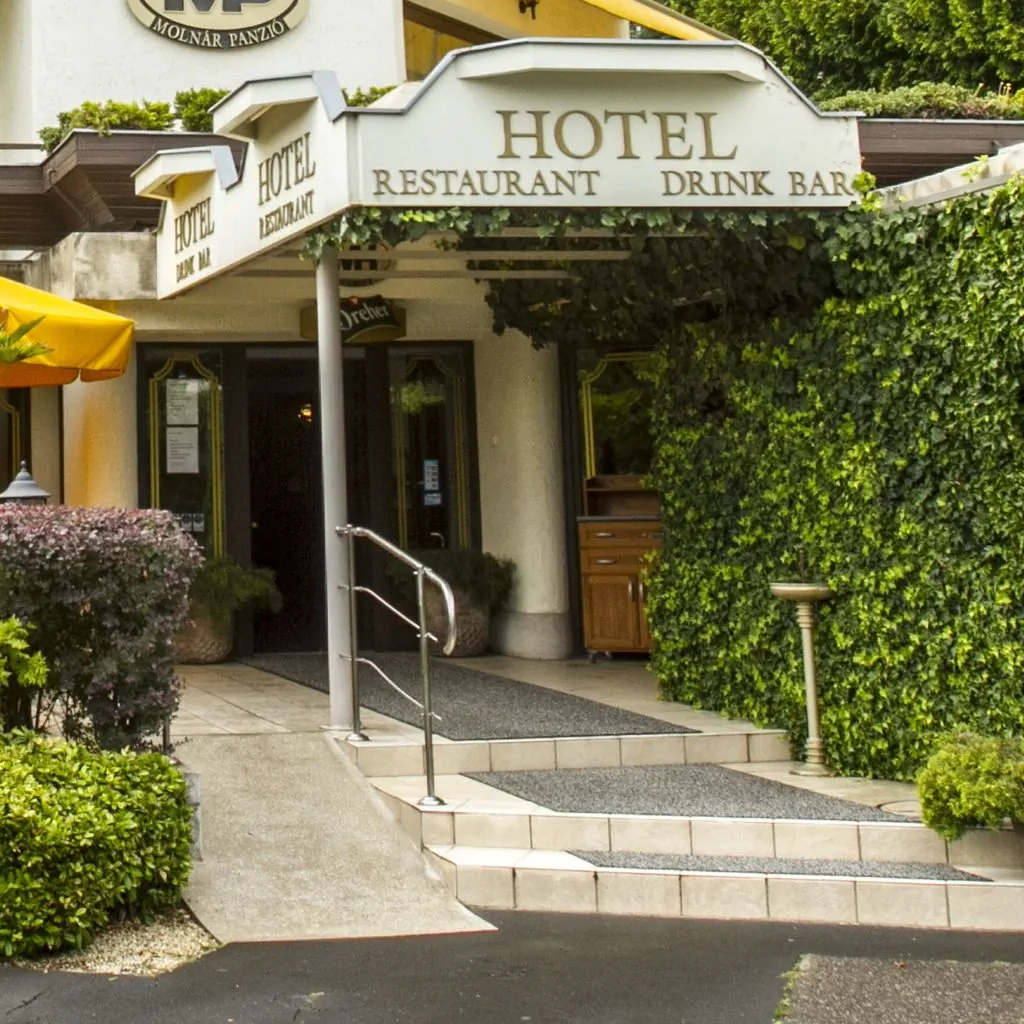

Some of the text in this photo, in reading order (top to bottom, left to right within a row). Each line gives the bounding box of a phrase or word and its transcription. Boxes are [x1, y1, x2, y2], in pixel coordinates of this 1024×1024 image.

[153, 18, 285, 48] MOLNÁR PANZIÓ
[495, 109, 738, 160] HOTEL
[258, 131, 317, 207] HOTEL
[372, 168, 855, 196] RESTAURANT DRINK BAR
[174, 196, 216, 255] HOTEL
[258, 189, 315, 241] RESTAURANT
